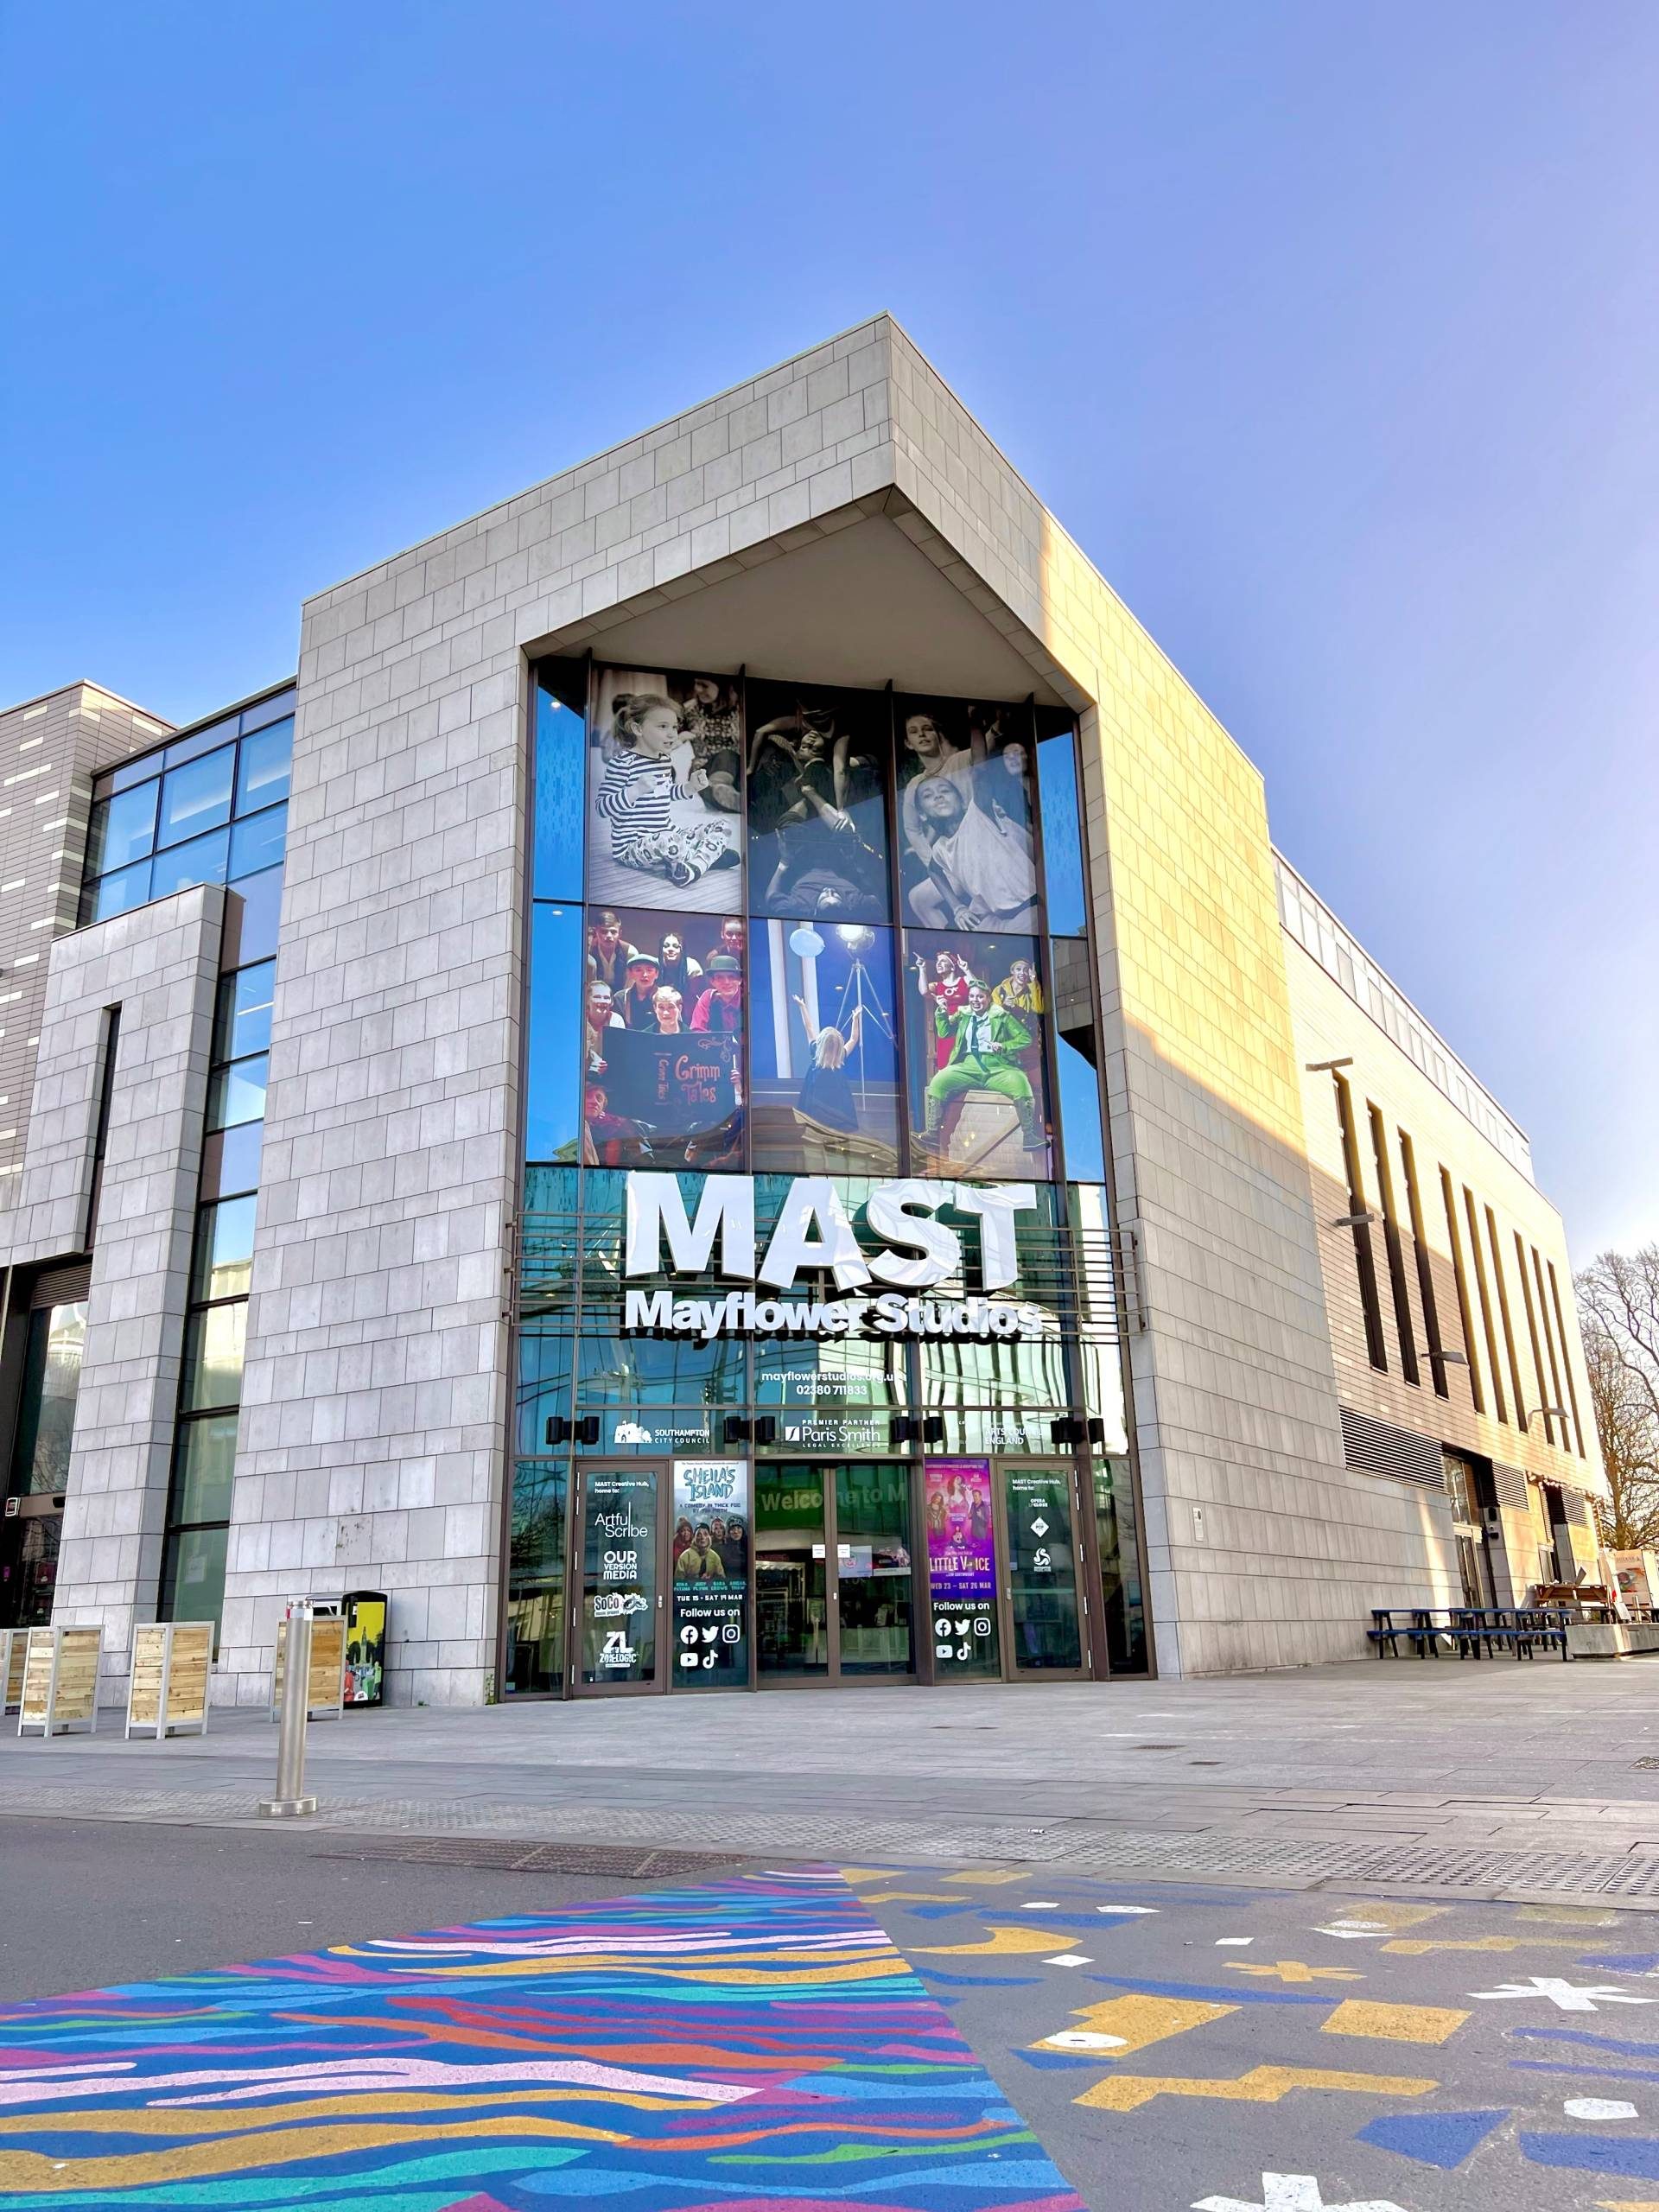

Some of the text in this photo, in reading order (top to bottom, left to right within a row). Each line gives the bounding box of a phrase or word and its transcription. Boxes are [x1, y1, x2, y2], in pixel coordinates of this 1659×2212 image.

[674, 1054, 721, 1082] Grimm
[681, 1082, 717, 1106] Tales
[626, 1170, 1038, 1293] MAST
[626, 1290, 1043, 1338] Mayflower Studios
[761, 1370, 899, 1384] mayflowerstudios.org.u
[797, 1384, 868, 1395] 02380 711833
[802, 1426, 880, 1442] Paris Smith
[985, 1427, 1005, 1436] ARTS
[688, 1483, 734, 1501] ISLAND
[861, 1484, 884, 1504] to
[594, 1502, 631, 1527] Artful
[605, 1523, 648, 1538] Scribe
[603, 1550, 638, 1564] OUR
[929, 1556, 959, 1572] LITTLE
[603, 1570, 638, 1580] MEDIA
[594, 1596, 620, 1611] SoCo
[933, 1601, 963, 1611] Follow
[680, 1607, 713, 1618] Follow
